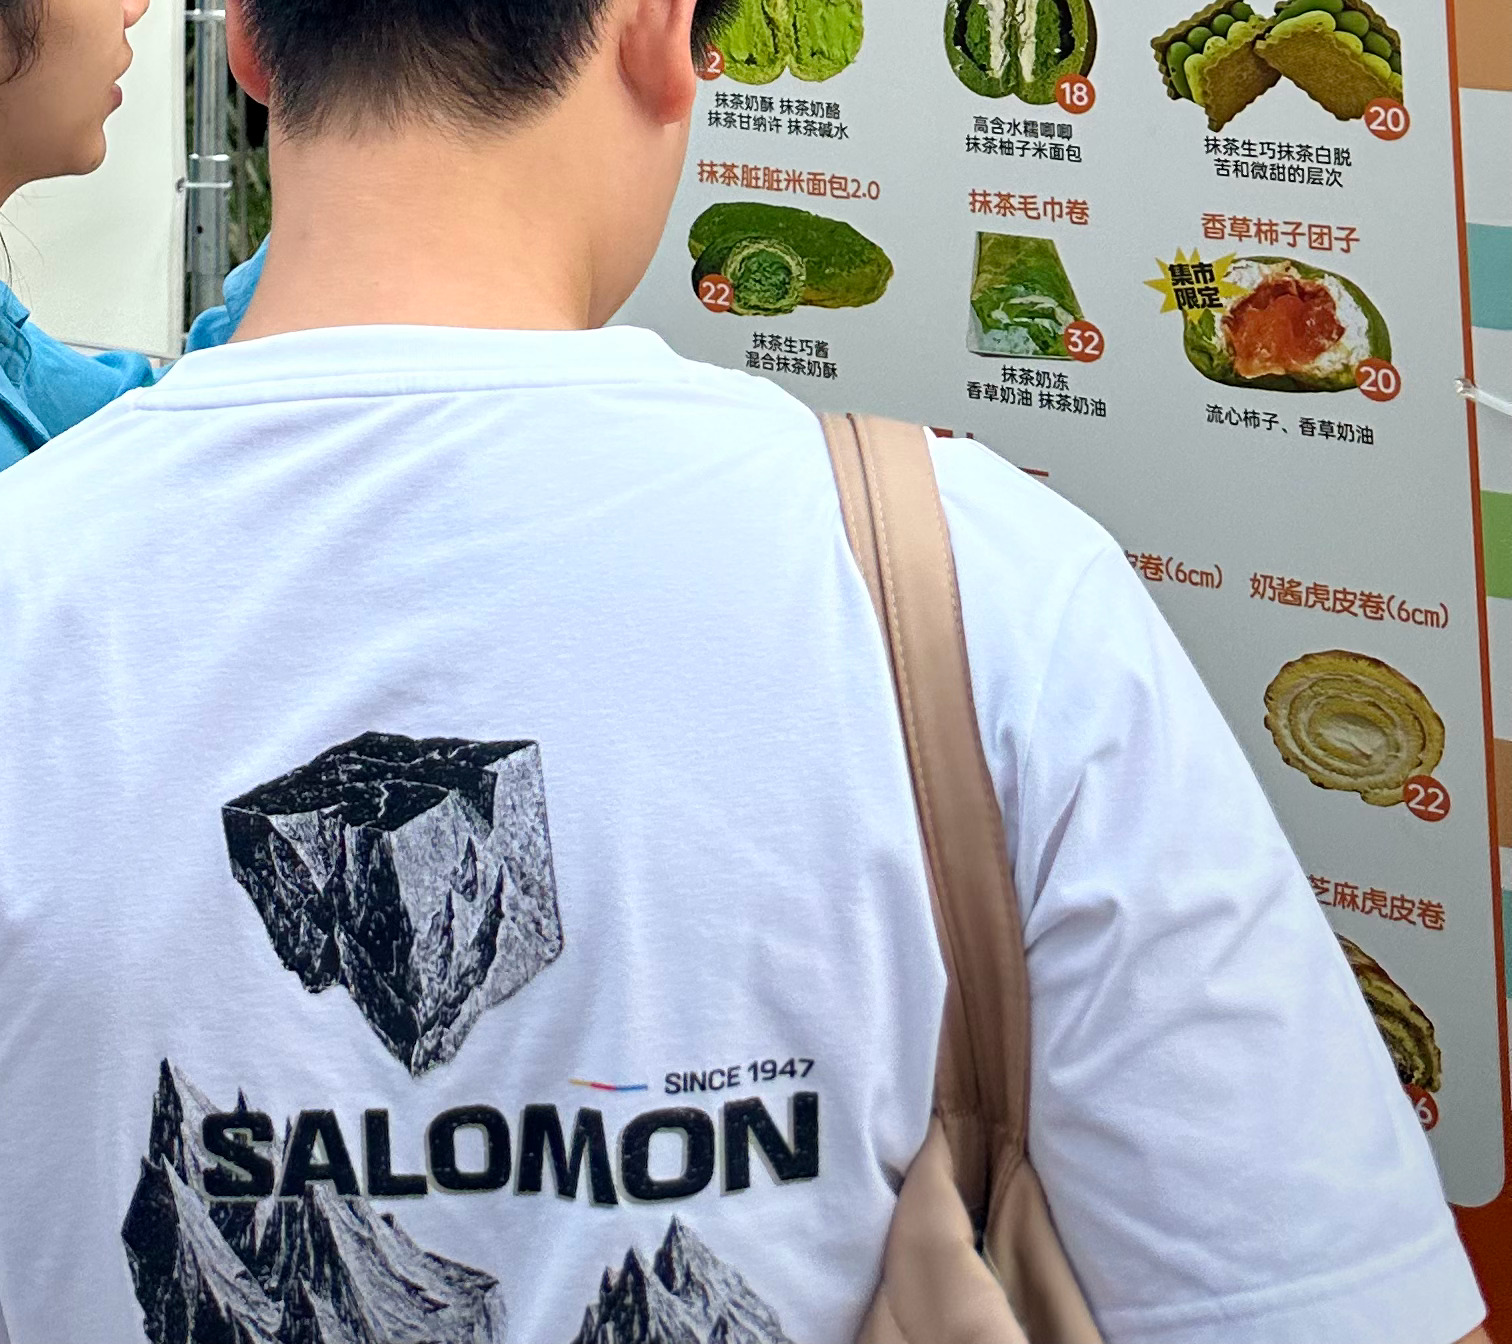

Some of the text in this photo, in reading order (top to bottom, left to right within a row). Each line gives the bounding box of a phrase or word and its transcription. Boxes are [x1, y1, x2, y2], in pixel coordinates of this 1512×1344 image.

[715, 91, 841, 120] 抹茶奶酥 抹茶奶酪
[1060, 82, 1088, 105] 18
[707, 111, 849, 141] 抹茶甘纳许 抹茶碱水
[1368, 107, 1405, 133] 20
[965, 134, 1082, 163] 抹茶柚子米面包
[1204, 136, 1352, 167] 抹茶生巧抹茶白脱
[697, 160, 880, 200] 抹茶脏脏米面包2.0
[1214, 158, 1343, 187] 苦和微甜的层次
[968, 188, 1089, 225] 抹茶毛巾卷
[1201, 212, 1359, 253] 香草柿子团子
[1168, 262, 1215, 286] 集市
[702, 283, 730, 306] 22
[1173, 285, 1224, 311] 限定
[752, 332, 829, 359] 抹茶生巧酱
[1068, 329, 1099, 355] 32
[745, 350, 838, 380] 混合抹茶奶酥
[1001, 365, 1069, 391] 抹茶奶冻
[1360, 367, 1396, 394] 20
[967, 380, 1106, 418] 香草奶油 抹茶奶油
[1205, 403, 1374, 445] 流心柿子、香草奶油
[1408, 783, 1445, 815] 22
[1307, 874, 1446, 932] 芝麻虎皮卷
[665, 1058, 814, 1095] SINCE 1947
[1414, 1098, 1433, 1123] 6
[202, 1092, 820, 1206] SALOMON
